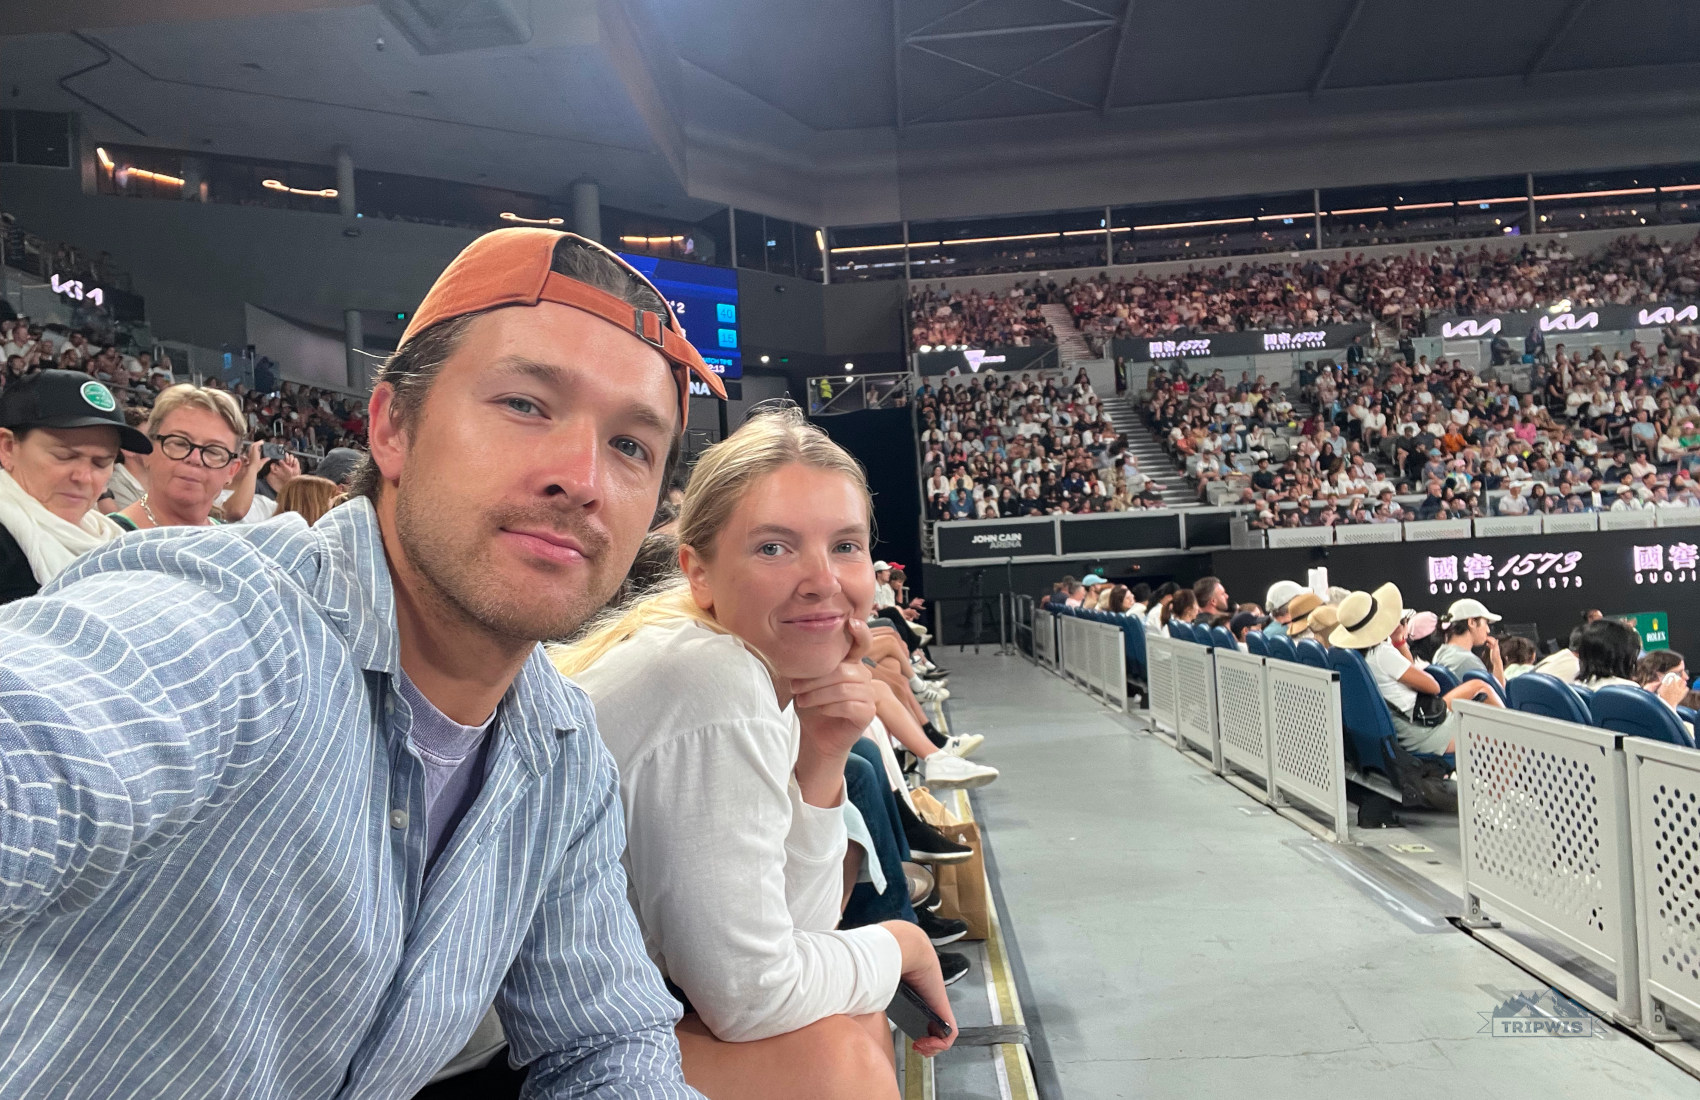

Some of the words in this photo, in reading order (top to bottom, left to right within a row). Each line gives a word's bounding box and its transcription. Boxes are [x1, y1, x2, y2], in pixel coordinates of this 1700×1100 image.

[720, 308, 733, 319] 40
[1638, 304, 1698, 325] KIA
[1540, 311, 1599, 332] KIA
[1442, 318, 1502, 338] KIA
[721, 333, 735, 344] 15
[689, 381, 711, 396] NA
[971, 534, 998, 544] JOHN
[998, 532, 1022, 542] CAIN
[989, 540, 1022, 549] ARENA
[1646, 631, 1667, 642] ROLEX
